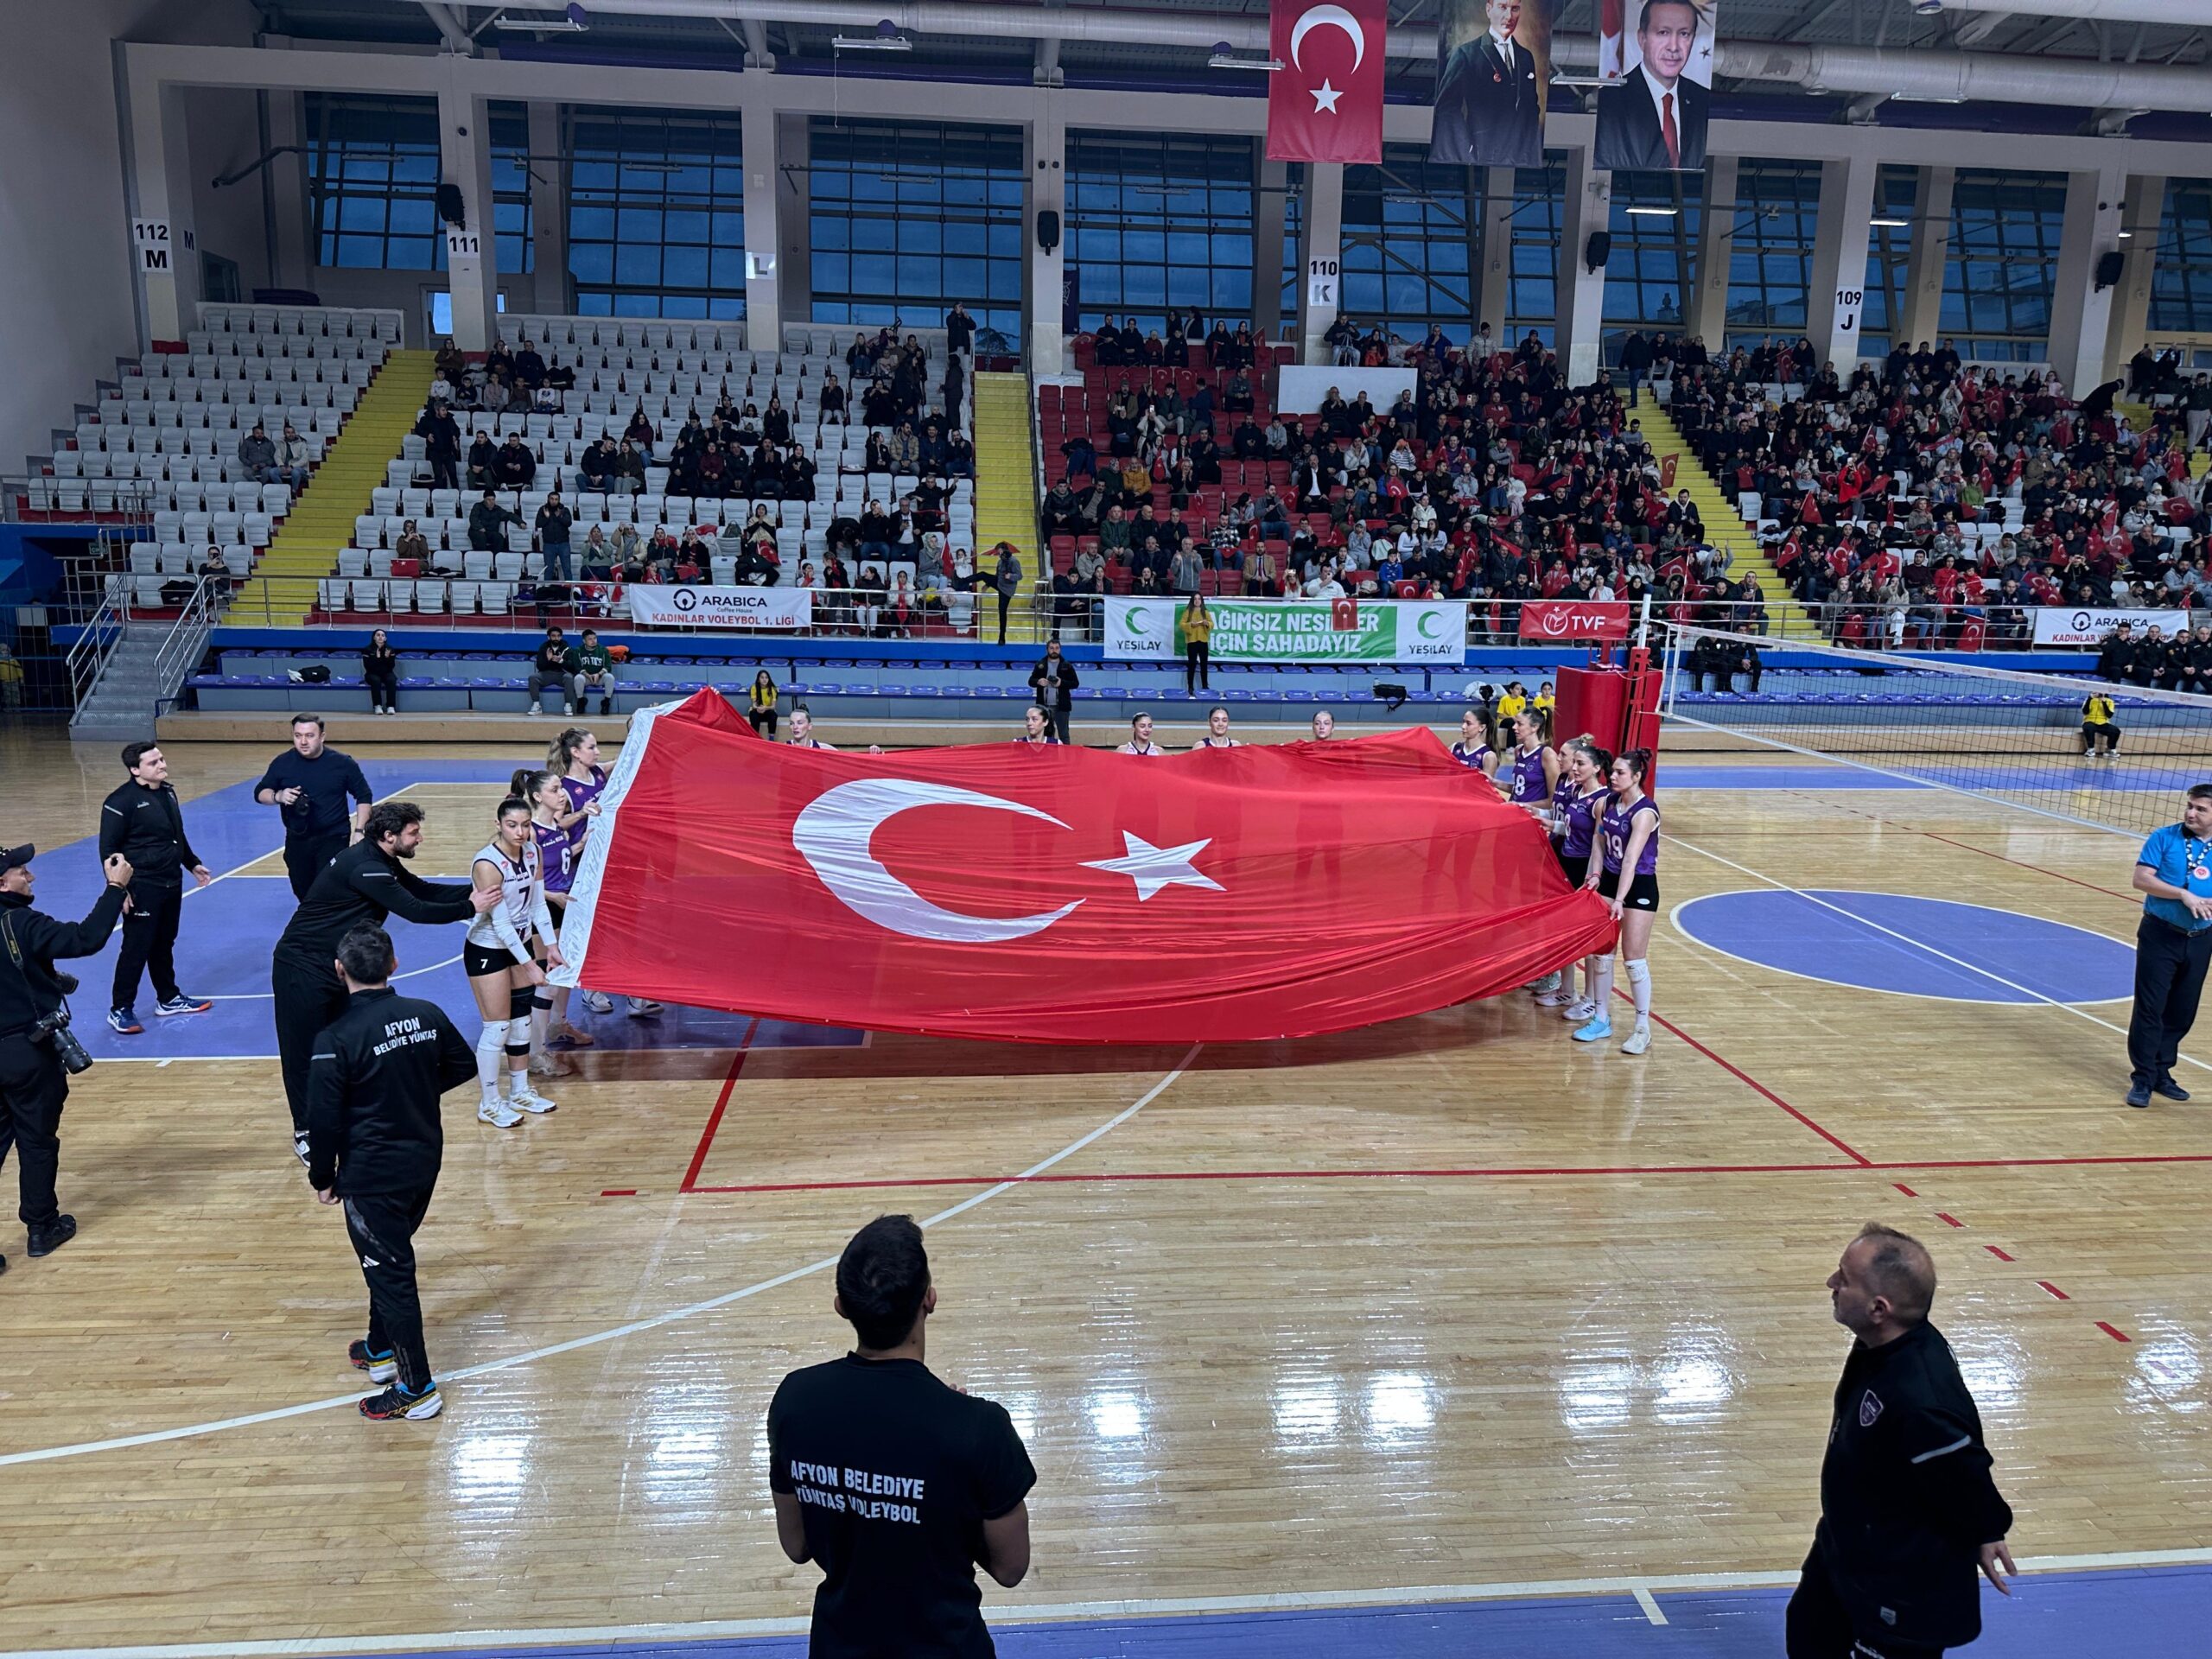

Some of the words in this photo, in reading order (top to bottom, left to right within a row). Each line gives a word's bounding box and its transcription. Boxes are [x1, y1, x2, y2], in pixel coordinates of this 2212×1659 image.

[136, 224, 168, 240] 112
[183, 230, 194, 251] M
[449, 237, 479, 253] 111
[145, 250, 168, 269] M
[753, 257, 768, 276] L
[1310, 260, 1338, 276] 110
[1314, 284, 1331, 302] K
[1836, 290, 1862, 305] 109
[1840, 314, 1853, 330] J
[701, 595, 768, 607] ARABICA
[652, 613, 704, 624] KADINLAR
[708, 614, 761, 626] VOLEYBOL
[764, 616, 772, 626] 1.
[775, 615, 795, 626] LİGİ
[1286, 613, 1379, 632] NESİER
[1571, 615, 1606, 631] TVF
[1252, 633, 1362, 653] SAHADAYIZ
[2052, 633, 2095, 643] KADINLAR
[561, 847, 571, 875] 6
[518, 886, 531, 912] 7
[480, 958, 488, 969] 7
[385, 1016, 421, 1039] AFYON
[791, 1459, 839, 1487] AFYON
[795, 1484, 846, 1513] YÜNTAŞ
[848, 1493, 921, 1525] VOLEYBOL
